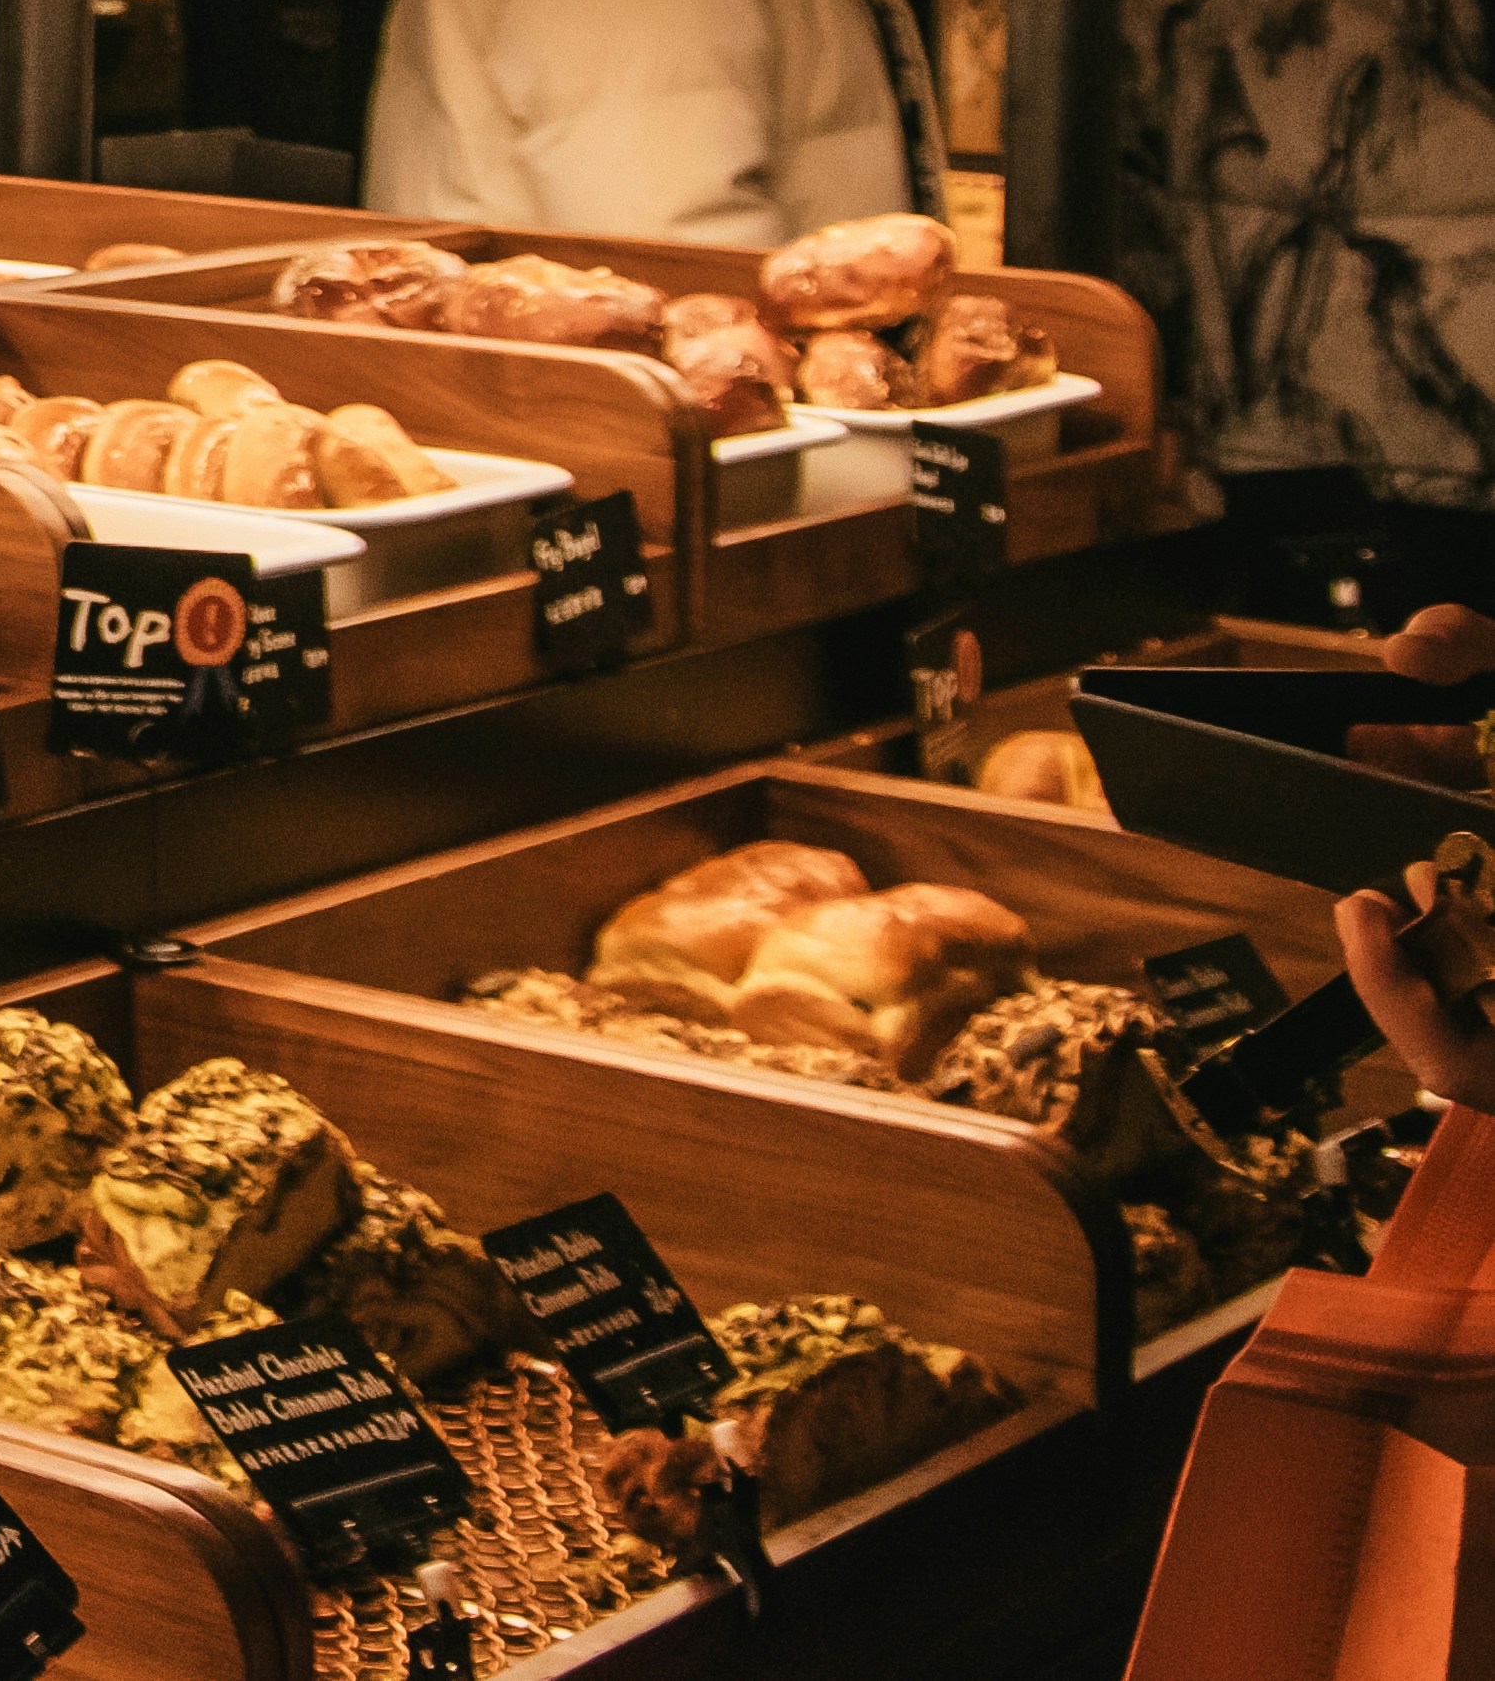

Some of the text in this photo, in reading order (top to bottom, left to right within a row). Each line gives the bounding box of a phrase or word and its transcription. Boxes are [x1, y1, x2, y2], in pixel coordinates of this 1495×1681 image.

[61, 587, 172, 669] Top
[178, 1342, 350, 1400] Hazelnut Chocolate
[201, 1368, 394, 1436] Babka Cinnamon Rolls
